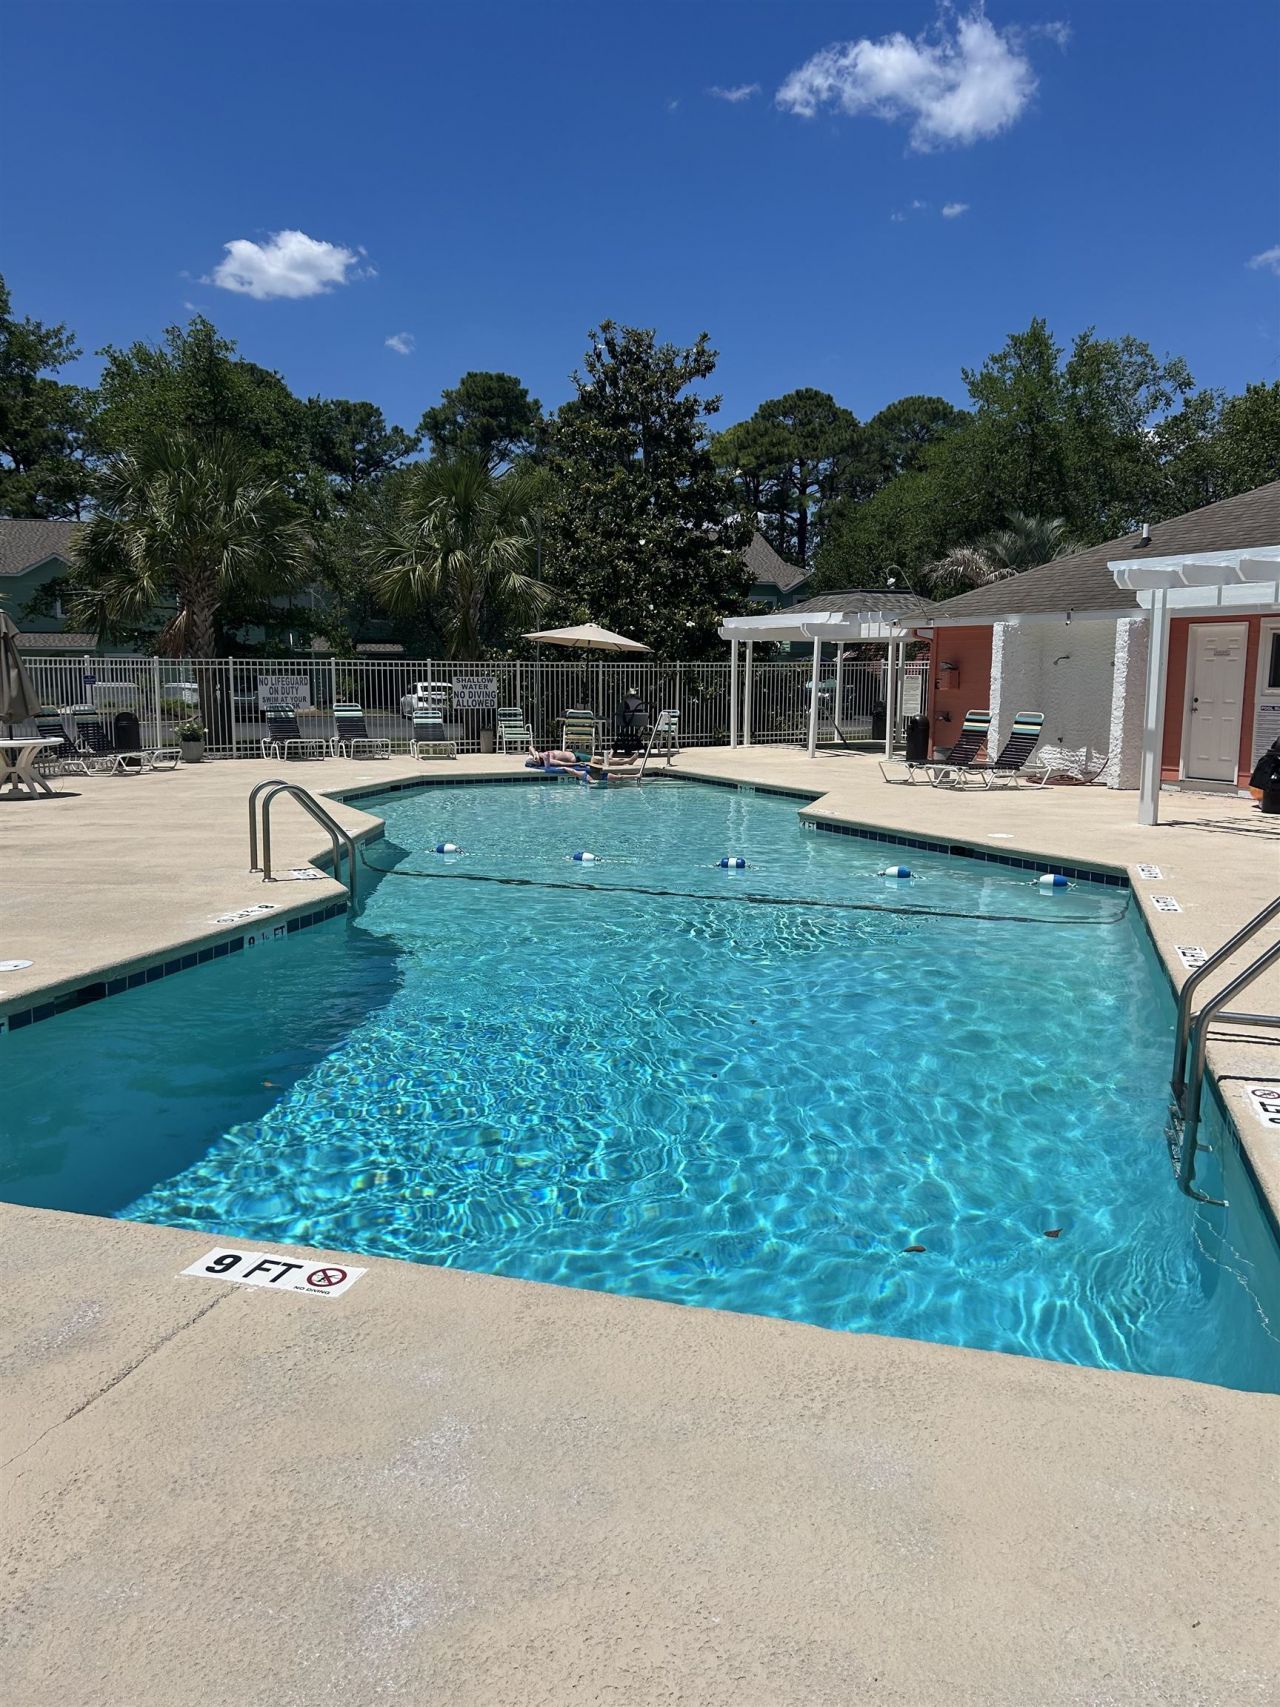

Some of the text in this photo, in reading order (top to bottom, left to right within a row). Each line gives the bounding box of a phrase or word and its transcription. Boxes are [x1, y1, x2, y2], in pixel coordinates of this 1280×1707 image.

[258, 676, 309, 686] NO LIFEGUARD
[269, 686, 299, 695] ON DUTY
[454, 690, 497, 699] NO DIVING
[291, 695, 307, 703] YOUR
[456, 699, 495, 708] ALLOWED
[205, 1254, 304, 1283] 9 FT
[305, 1287, 331, 1295] DIVING
